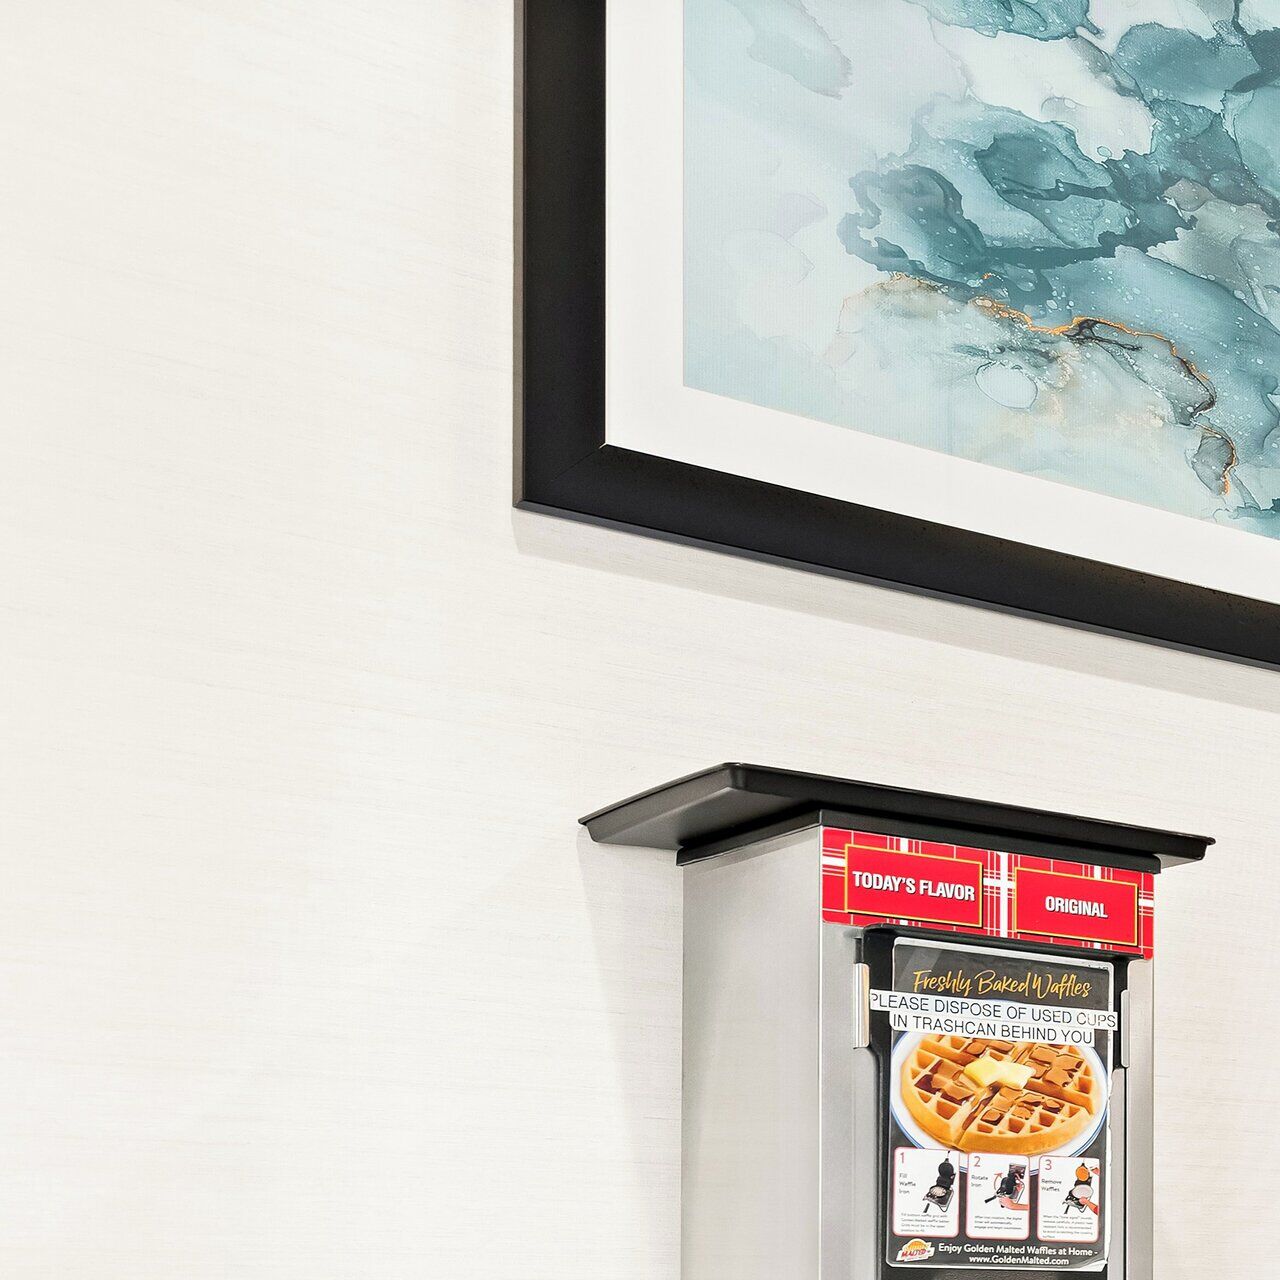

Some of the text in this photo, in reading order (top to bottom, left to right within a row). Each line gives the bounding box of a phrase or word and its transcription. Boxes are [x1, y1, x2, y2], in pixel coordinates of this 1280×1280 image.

[852, 870, 975, 902] TODAY'S FLAVOR
[1045, 896, 1108, 918] ORIGINAL
[913, 969, 1092, 999] Freshly Baked Waffles
[934, 999, 1002, 1019] DISPOSE
[1006, 1005, 1027, 1019] OF
[1031, 1007, 1072, 1023] USED
[1076, 1012, 1116, 1028] CUPS
[893, 1014, 1092, 1045] IN TRASHCAN BEHIND YOU
[900, 1153, 905, 1164] 1
[974, 1156, 981, 1167] 2
[1045, 1159, 1052, 1170] 3
[938, 1243, 962, 1257] Enjoy
[963, 1243, 994, 1254] Golden
[996, 1244, 1026, 1255] Malted
[1027, 1245, 1056, 1256] Waffles
[1058, 1247, 1067, 1256] at
[1068, 1246, 1093, 1257] Home
[969, 1255, 1069, 1266] www.GoldenMalted.com
